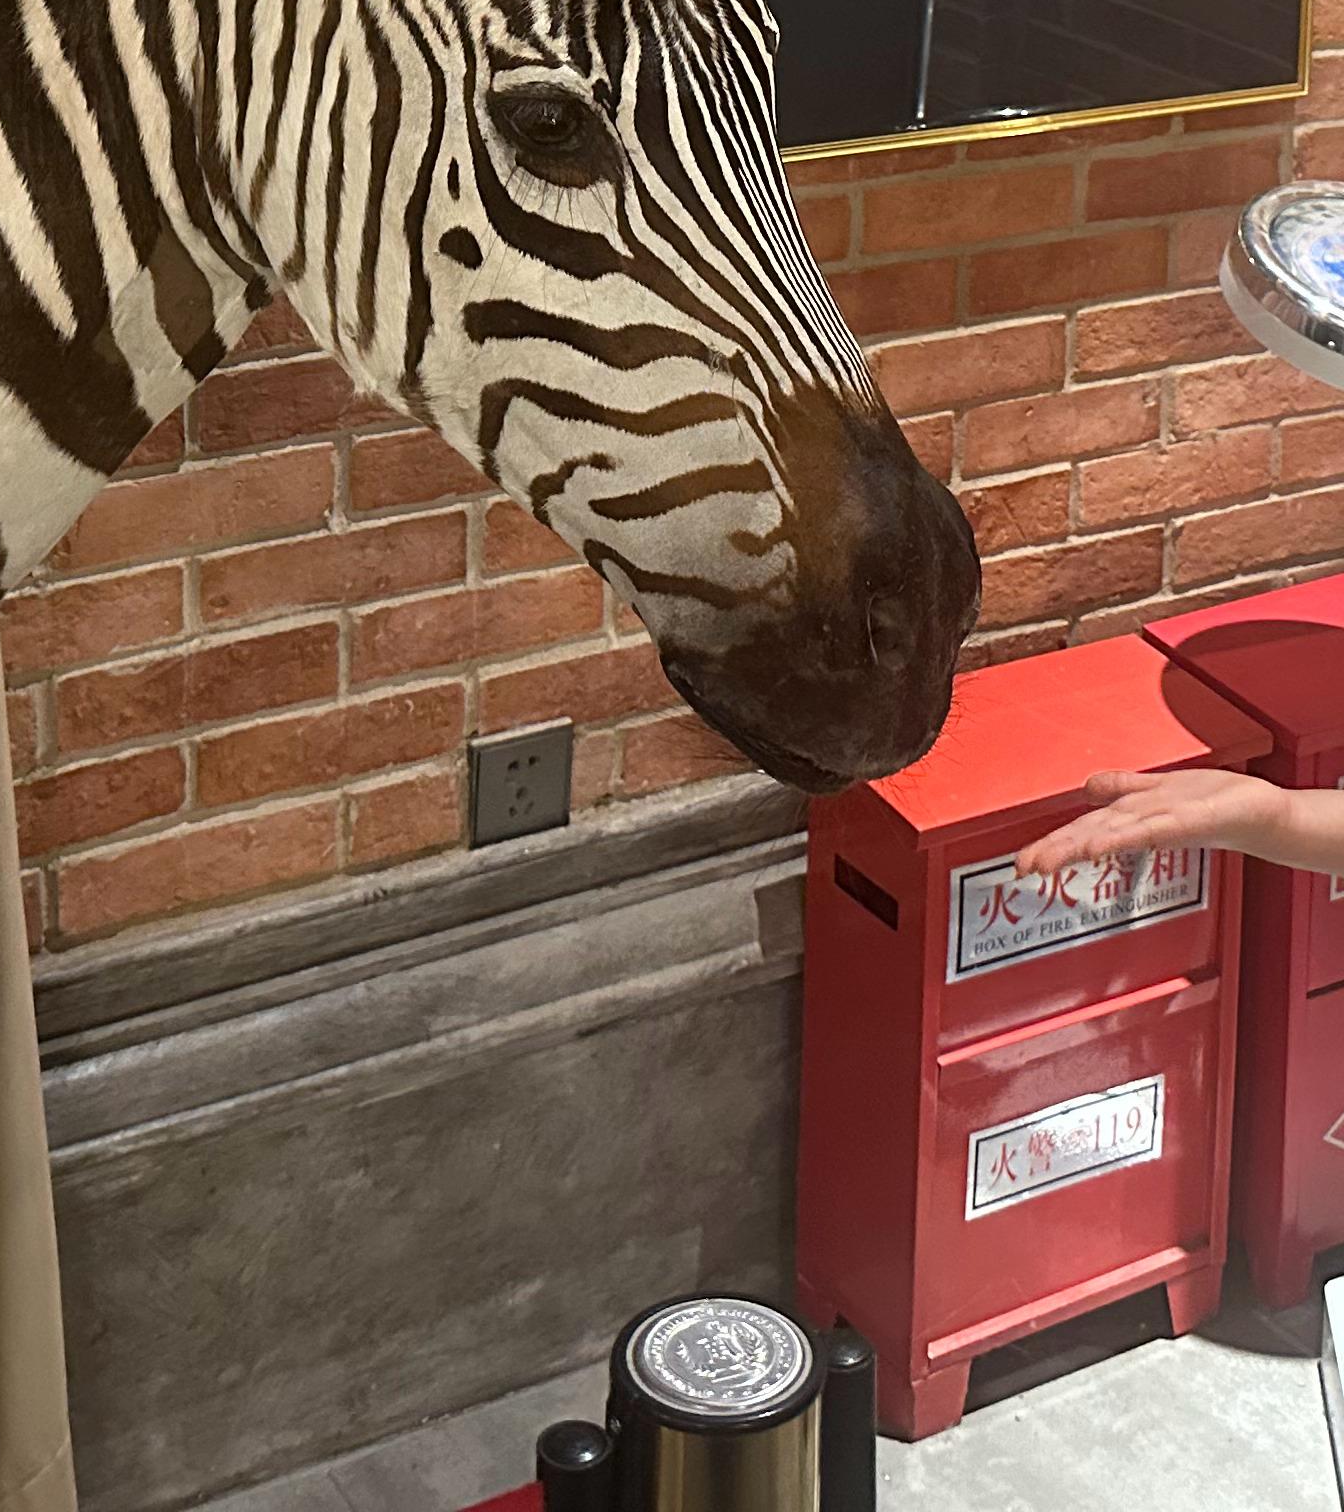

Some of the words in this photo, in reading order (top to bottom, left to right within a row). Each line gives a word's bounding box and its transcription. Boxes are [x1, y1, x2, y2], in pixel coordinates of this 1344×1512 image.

[974, 936, 1008, 956] BOX
[1013, 924, 1037, 944] OF
[1040, 917, 1074, 937] FIRE
[1080, 884, 1190, 925] EXTINGUISHER
